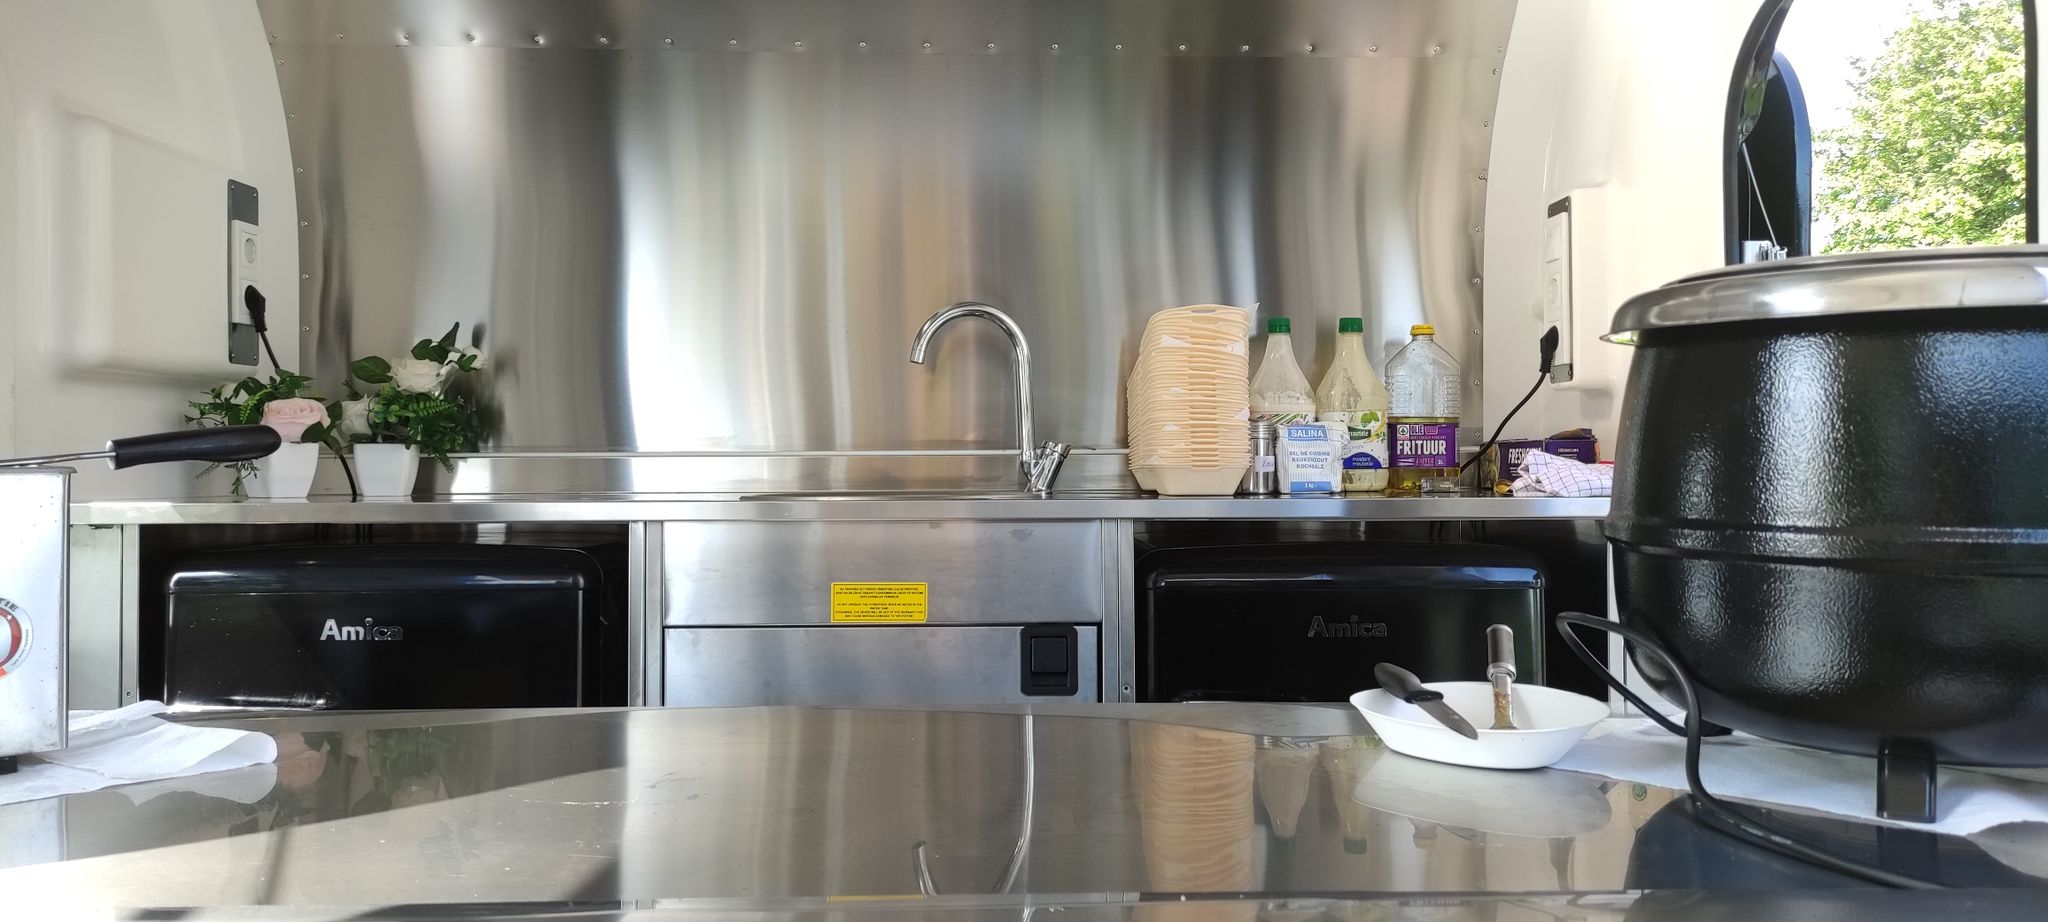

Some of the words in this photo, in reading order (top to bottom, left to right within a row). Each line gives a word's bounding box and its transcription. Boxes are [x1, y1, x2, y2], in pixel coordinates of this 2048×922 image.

[1291, 429, 1324, 438] SALINA
[1397, 440, 1447, 455] FRITUUR
[320, 617, 404, 641] Amica
[1307, 614, 1388, 638] Amica
